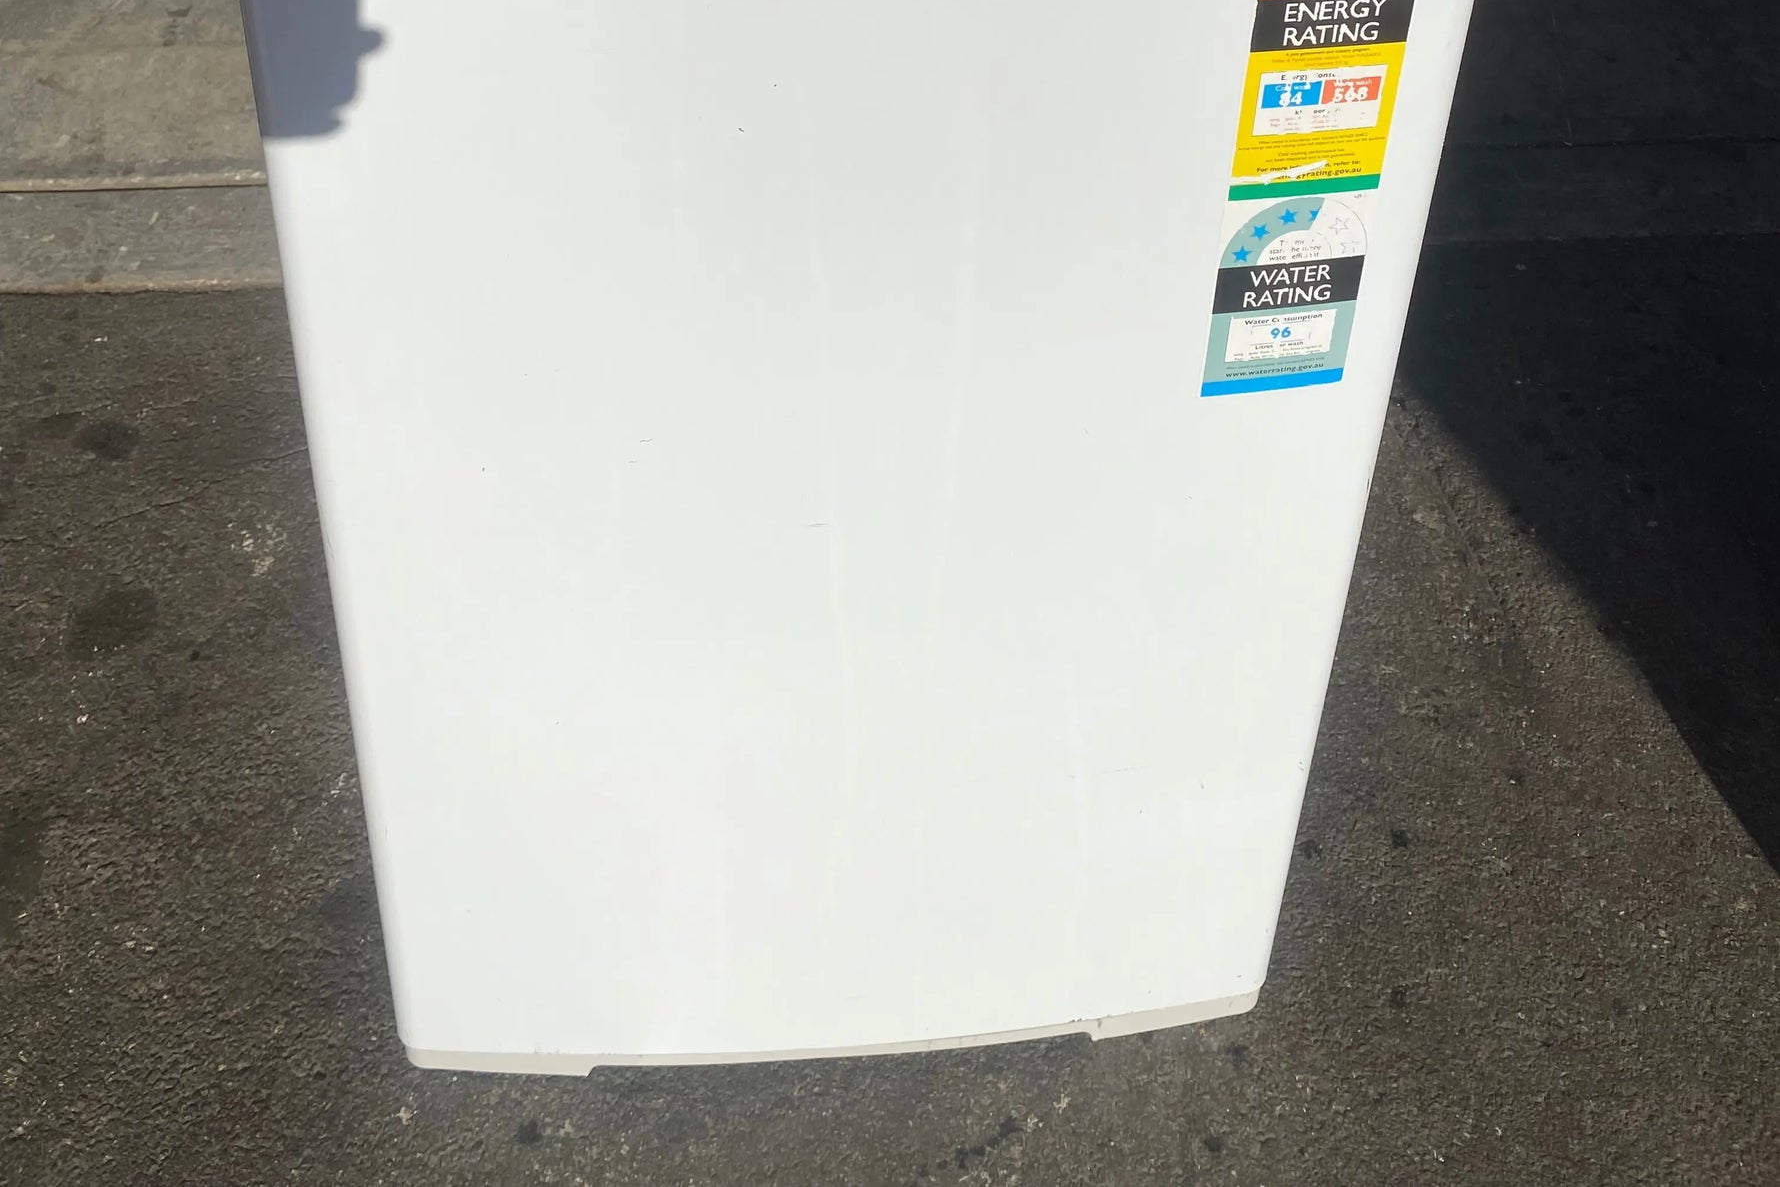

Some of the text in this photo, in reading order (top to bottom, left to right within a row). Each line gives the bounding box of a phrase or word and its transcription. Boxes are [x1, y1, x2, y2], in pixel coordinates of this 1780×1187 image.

[1282, 21, 1380, 46] RATING
[1250, 264, 1331, 287] WATER
[1242, 284, 1332, 308] RATING
[1270, 326, 1292, 340] 96
[1225, 363, 1324, 378] www.waterrating.gov.au
